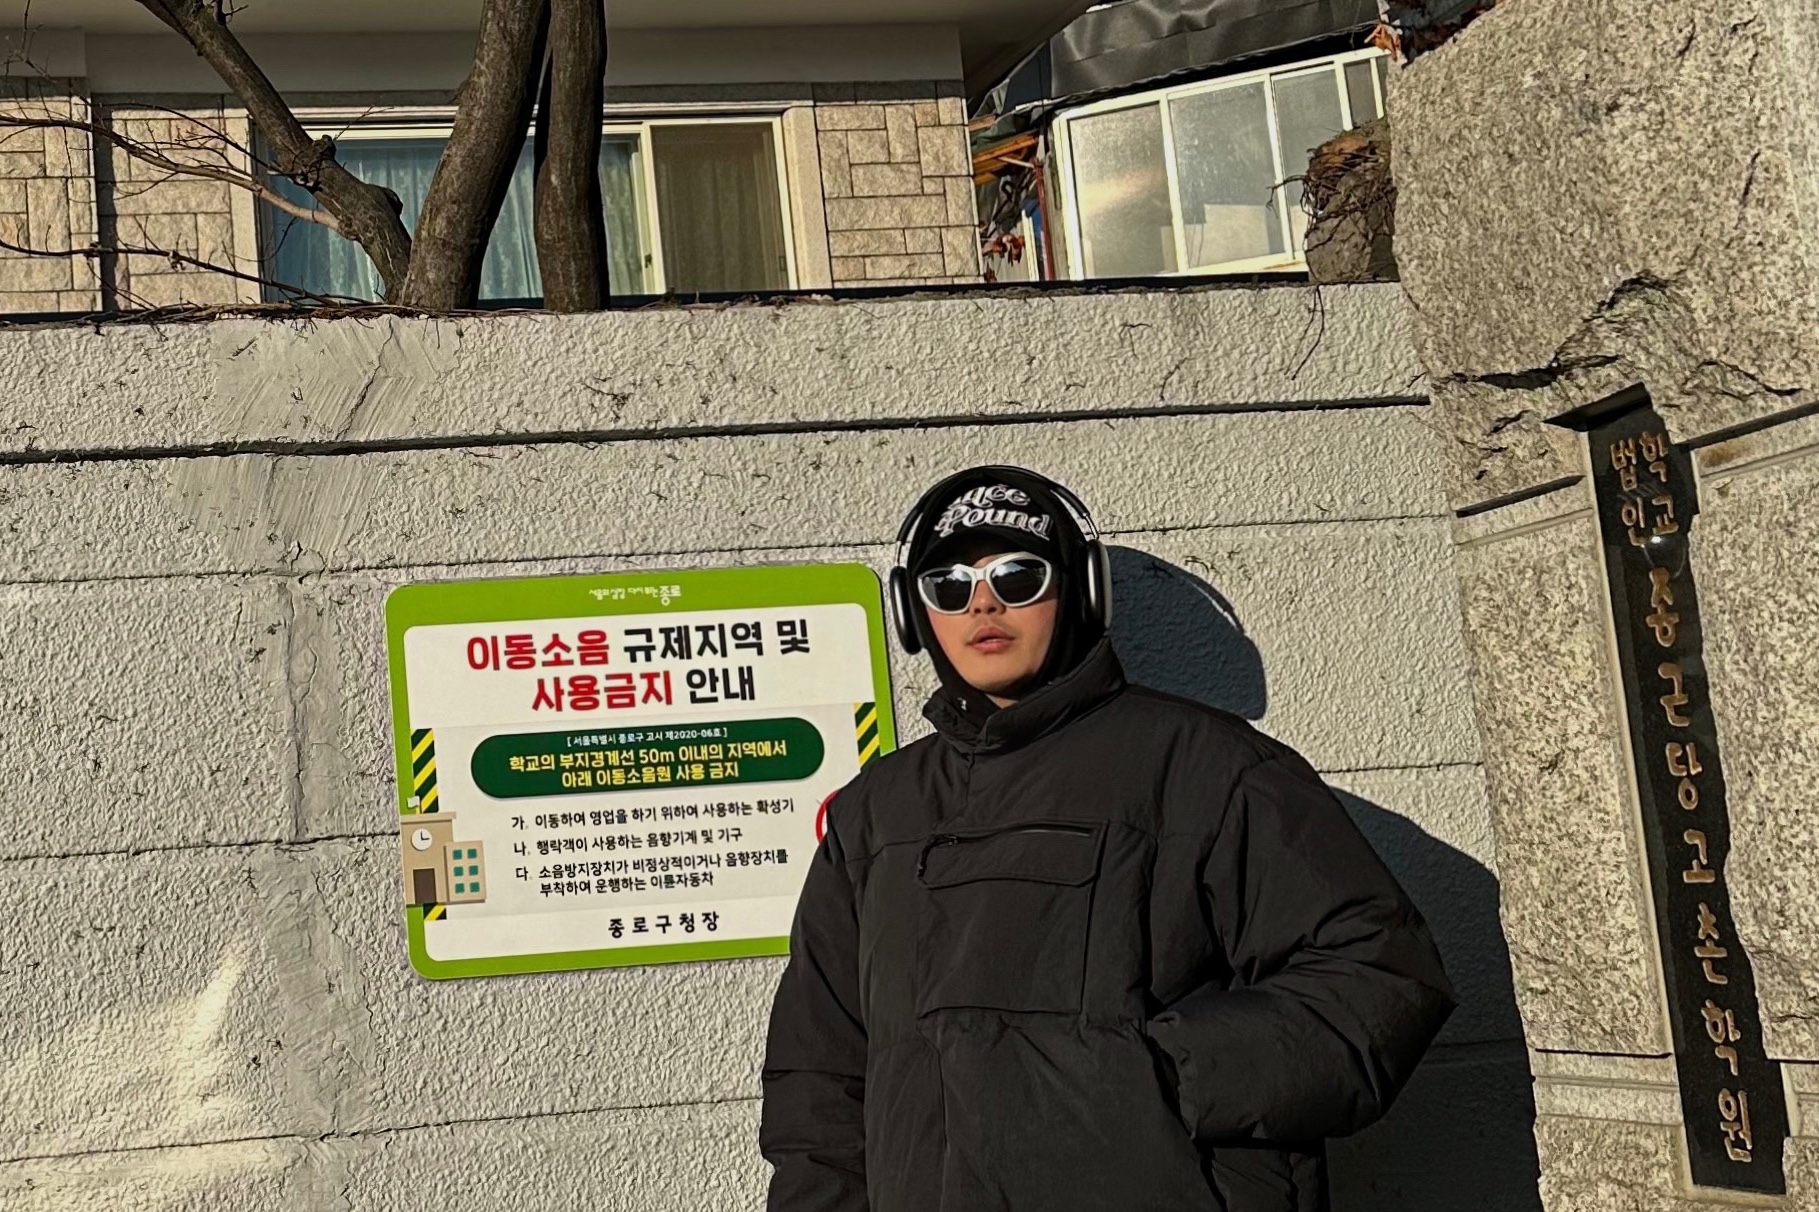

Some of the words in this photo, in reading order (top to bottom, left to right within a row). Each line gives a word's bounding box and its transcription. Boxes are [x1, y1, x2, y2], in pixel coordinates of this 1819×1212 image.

[659, 584, 682, 606] 종로
[467, 629, 610, 671] 이동소음
[623, 621, 764, 663] 규제지역
[776, 619, 811, 655] 및
[532, 670, 673, 712] 사용금지
[685, 665, 756, 704] 안내
[573, 733, 617, 746] 서울특별시
[617, 732, 644, 745] 종로구
[645, 730, 664, 742] 고시
[509, 753, 556, 773] 학교의
[559, 748, 635, 769] 부지경계선
[639, 748, 675, 764] 50m
[678, 743, 723, 762] 이내의
[727, 739, 788, 760] 지역에서
[561, 770, 592, 788] 아래
[596, 766, 671, 786] 이동소음원
[676, 762, 706, 782] 사용
[709, 760, 739, 780] 금지
[534, 811, 586, 830] 이동하여
[589, 808, 628, 826] 영업을
[631, 806, 657, 823] 하기
[660, 804, 699, 821] 위하여
[702, 801, 753, 819] 사용하는
[756, 797, 795, 815] 확성기
[536, 837, 588, 856] 행락객이
[591, 832, 643, 851] 사용하는
[646, 829, 697, 848] 음향기계
[701, 829, 714, 844] 및
[717, 827, 743, 843] 기구
[538, 860, 629, 880] 소음방지장치가
[632, 852, 722, 874] 비정상적이거나
[725, 848, 789, 868] 음향장치를
[540, 879, 592, 897] 부착하여
[595, 875, 647, 894] 운행하는
[650, 871, 714, 890] 이륜자동차
